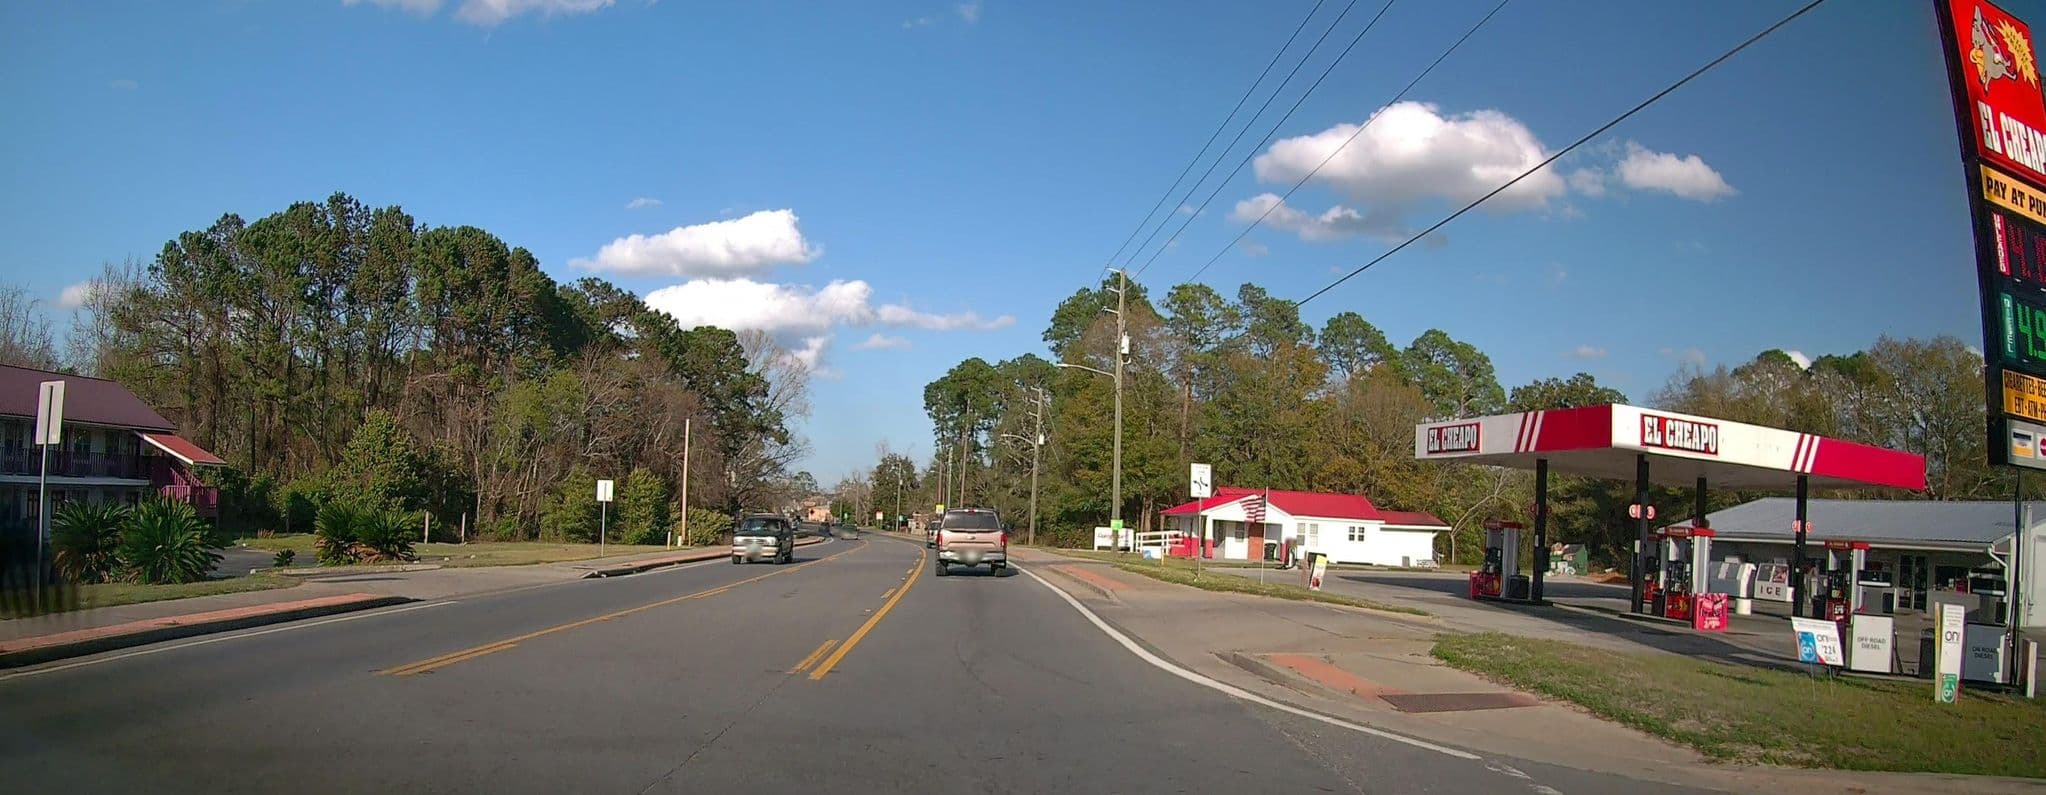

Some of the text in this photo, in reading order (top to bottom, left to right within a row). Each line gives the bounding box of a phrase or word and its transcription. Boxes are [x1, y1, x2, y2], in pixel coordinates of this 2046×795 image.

[1977, 100, 2002, 154] EL
[1986, 175, 2007, 200] PAY
[2011, 187, 2025, 208] AT
[1428, 424, 1477, 451] EL CHEAPO
[1644, 416, 1717, 453] EL CHEAPO
[1760, 585, 1781, 596] ICE
